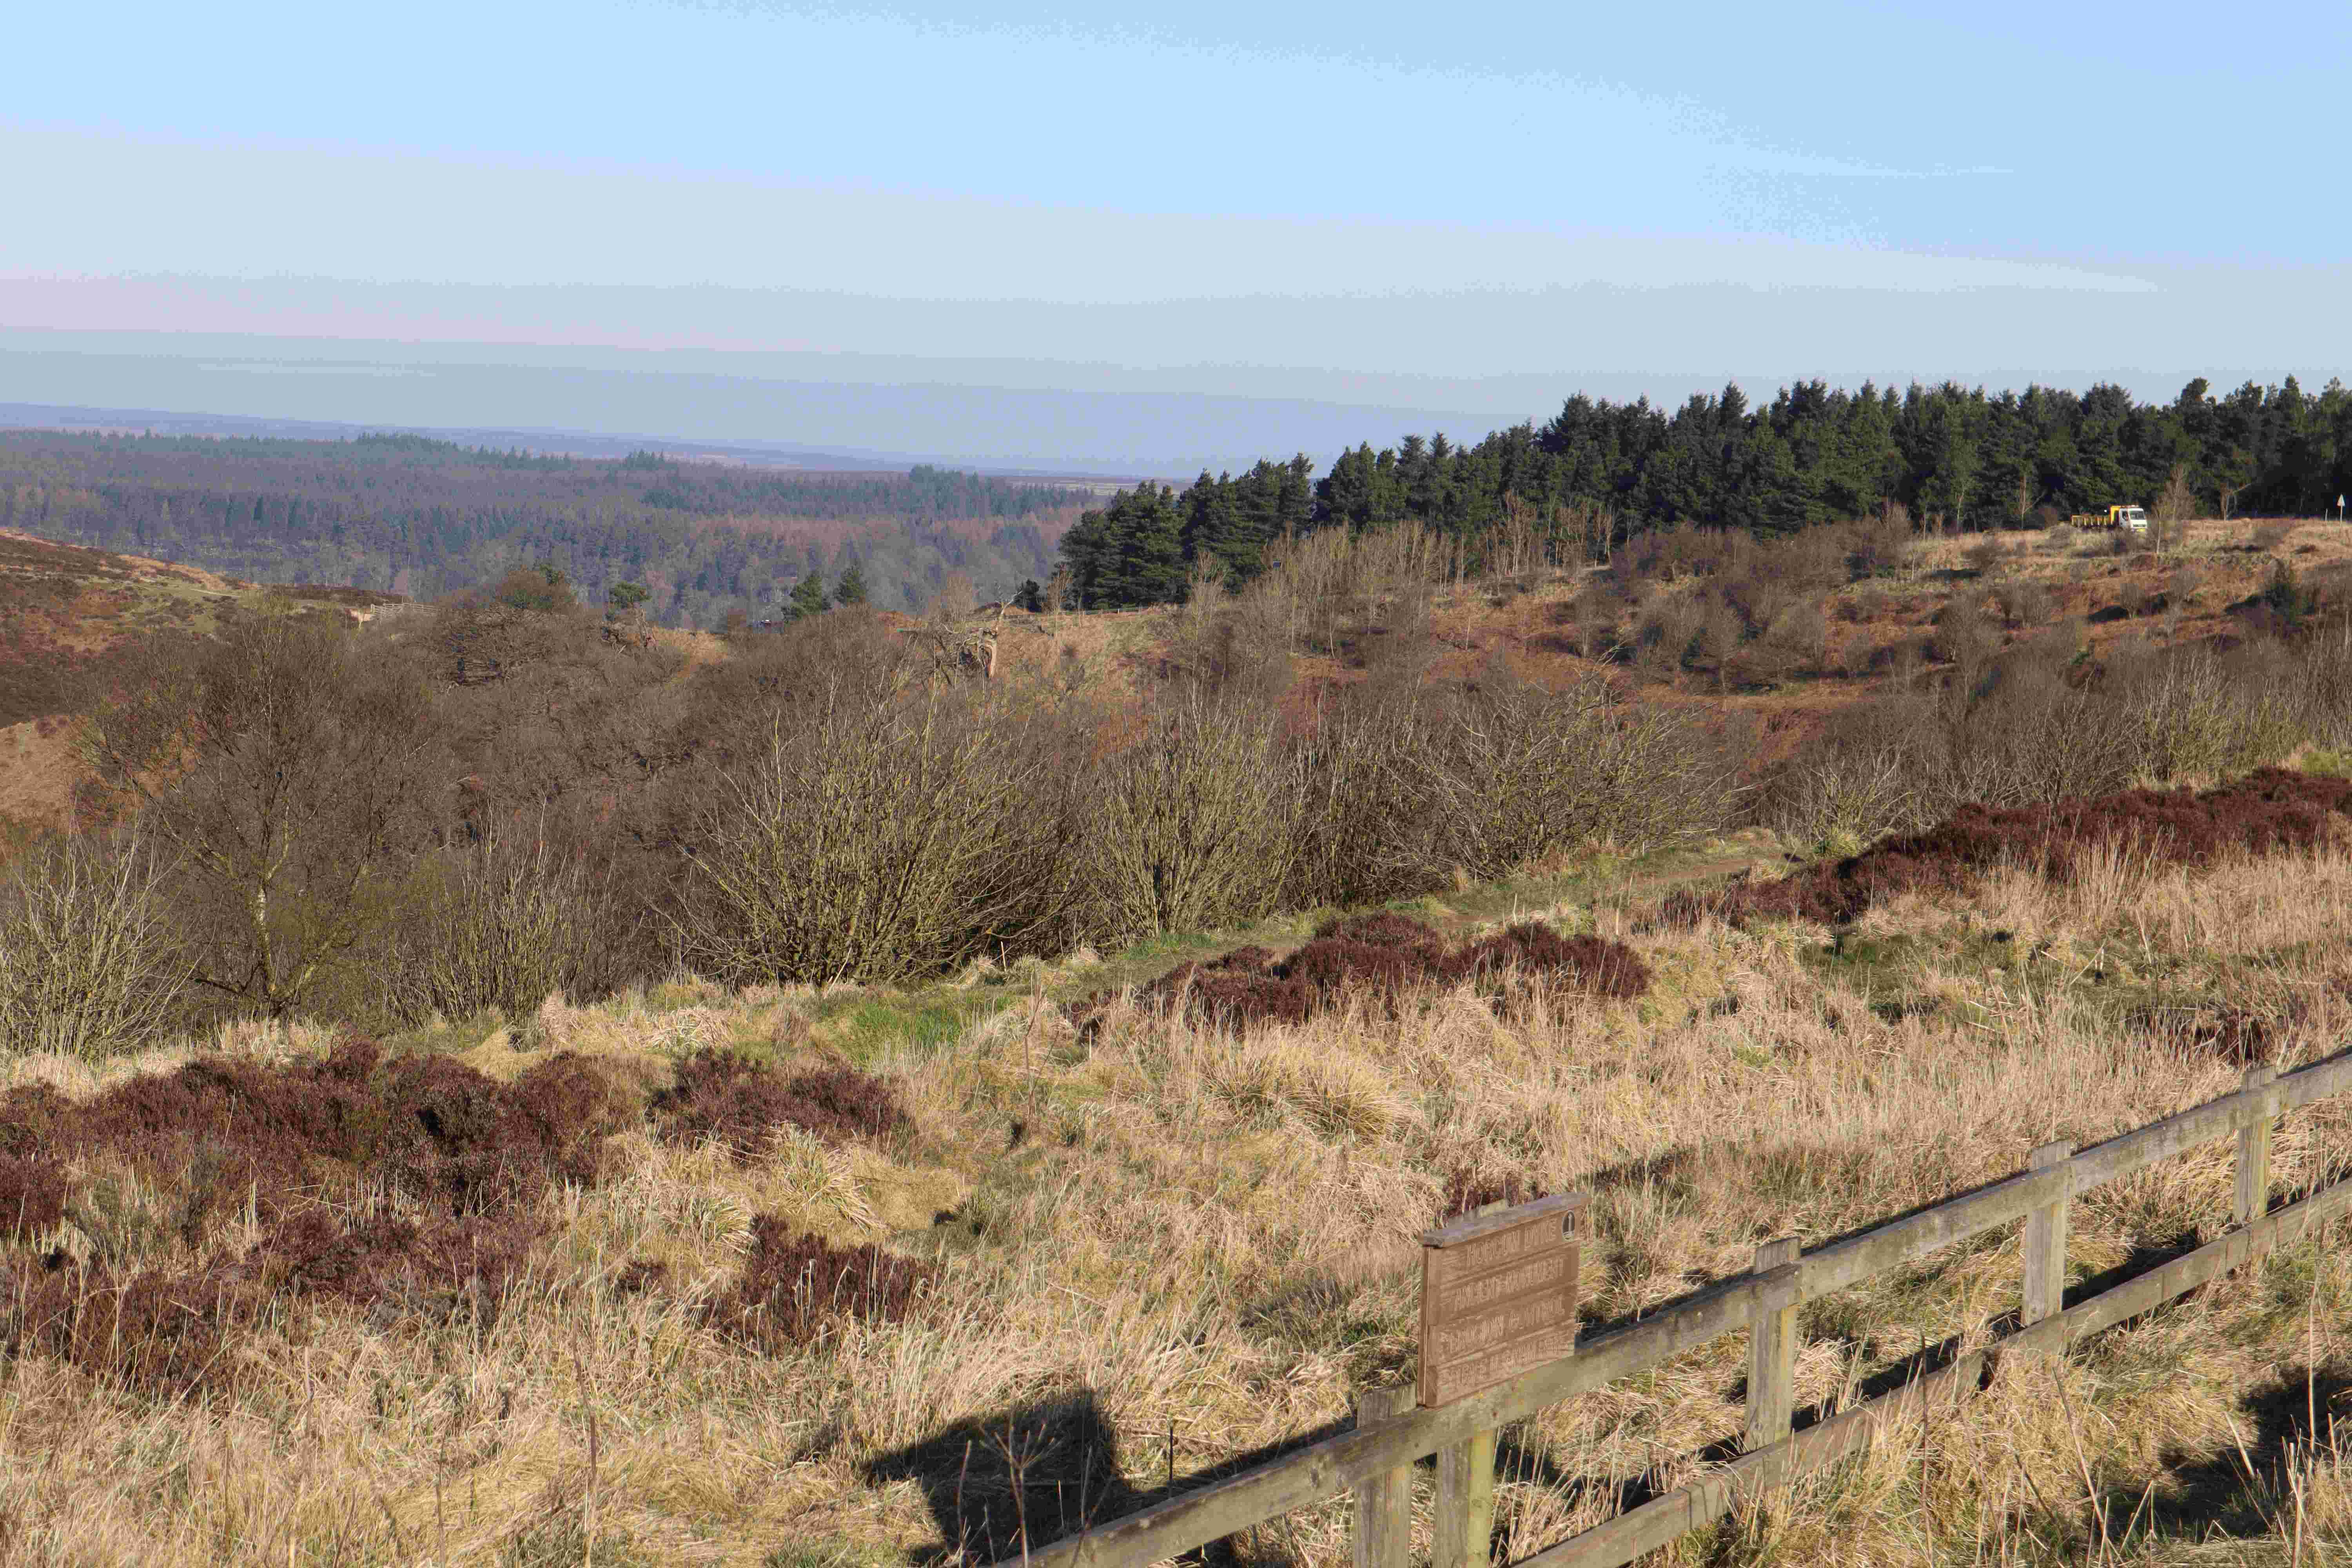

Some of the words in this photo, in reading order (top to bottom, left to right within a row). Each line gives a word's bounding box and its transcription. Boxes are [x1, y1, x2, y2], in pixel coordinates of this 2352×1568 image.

[1524, 1218, 1557, 1251] DYKE
[1455, 1276, 1500, 1310] ANCIENT
[1504, 1257, 1564, 1293] MONUMENT
